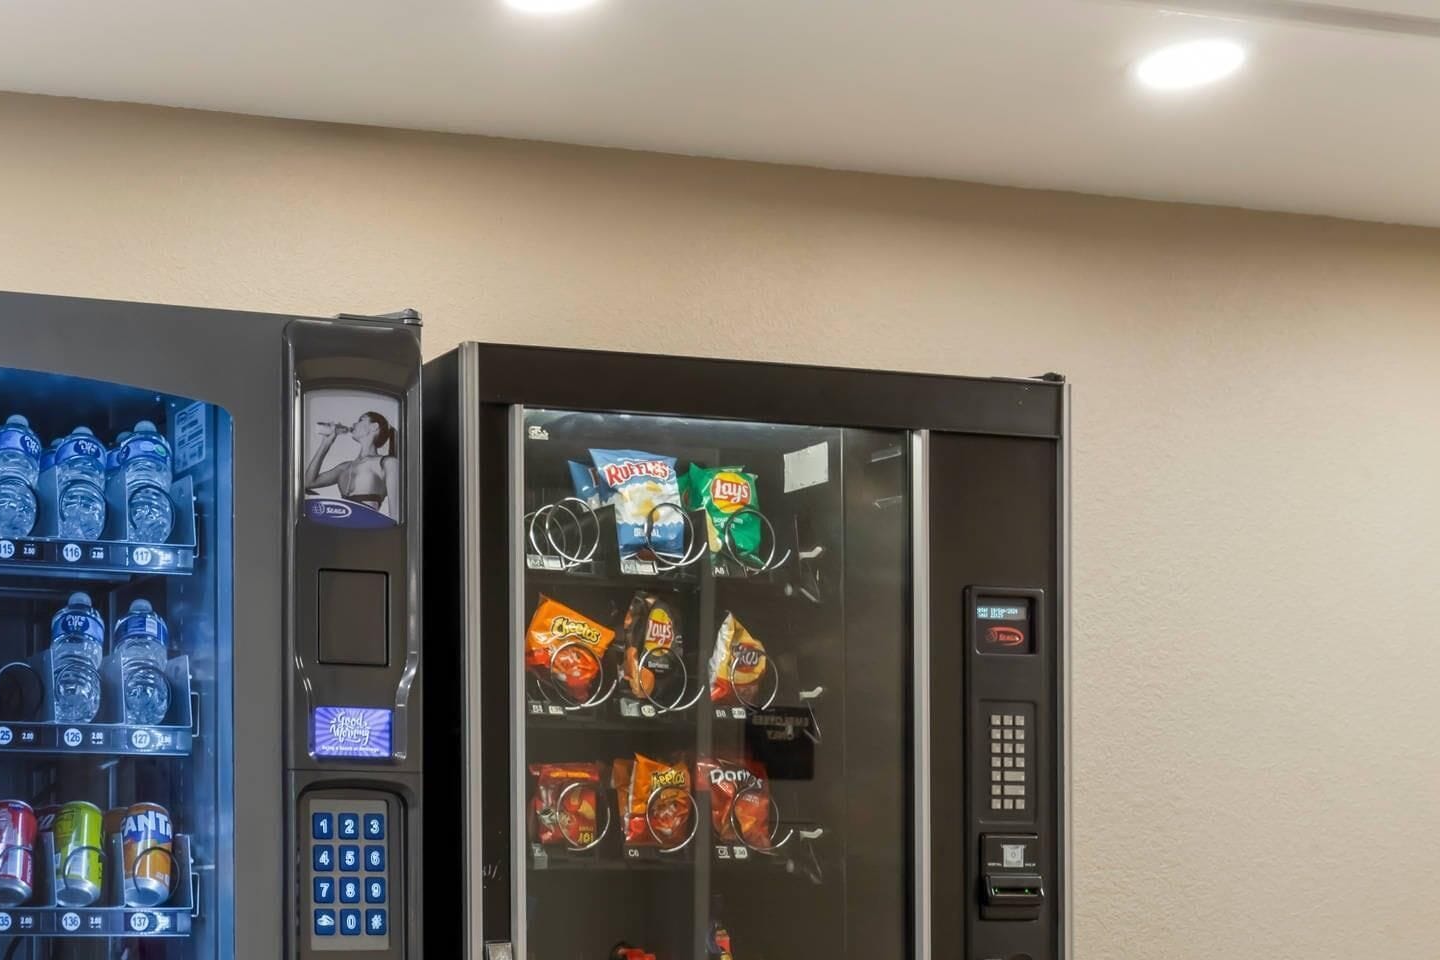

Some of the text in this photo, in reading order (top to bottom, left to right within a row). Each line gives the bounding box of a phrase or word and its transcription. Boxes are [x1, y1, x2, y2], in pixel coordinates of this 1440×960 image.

[605, 460, 670, 486] RUFFLES
[714, 479, 748, 503] Lay's
[64, 546, 80, 558] 116
[135, 551, 149, 561] 117
[551, 617, 600, 644] Cheetos
[336, 711, 364, 728] Good
[65, 731, 81, 743] 126
[134, 734, 149, 745] 127
[330, 725, 370, 745] Morning
[320, 819, 380, 834] 1 2 3
[319, 850, 380, 866] 4 5 6
[320, 882, 381, 898] 7 8 9
[63, 916, 79, 927] 136
[132, 916, 147, 927] 137
[346, 914, 357, 929] 0
